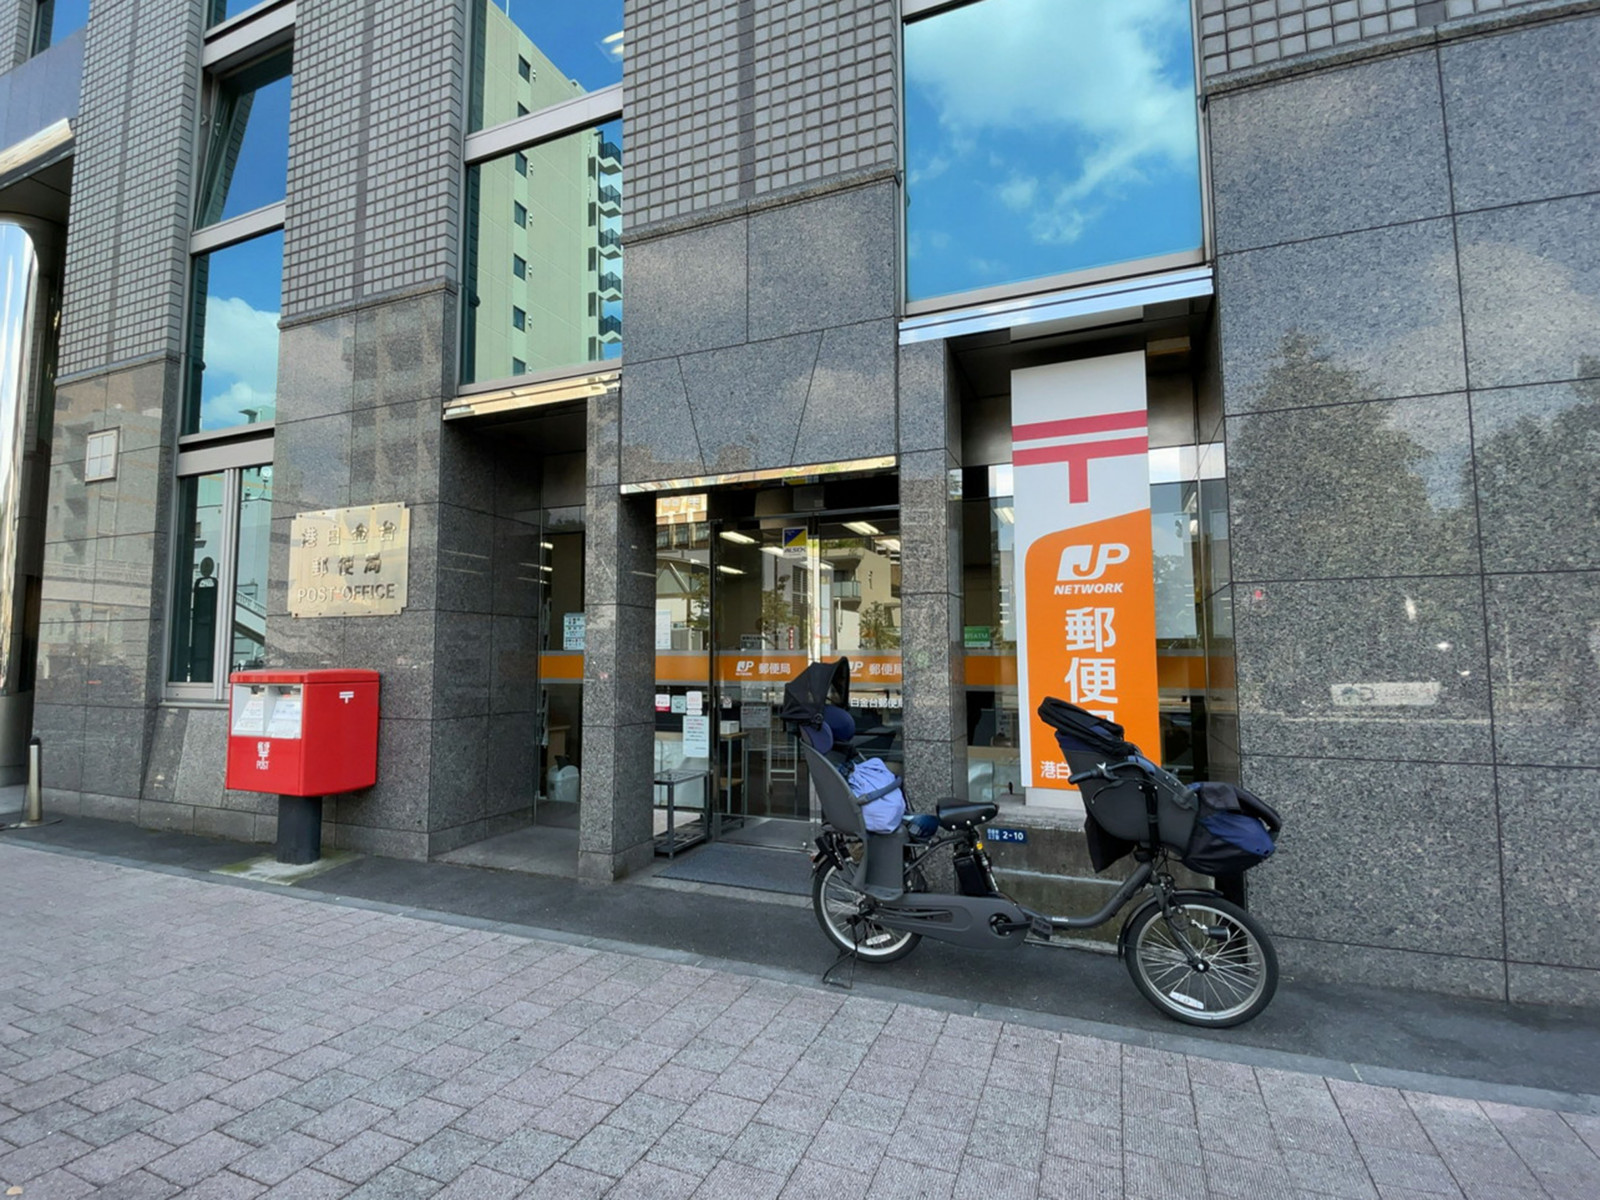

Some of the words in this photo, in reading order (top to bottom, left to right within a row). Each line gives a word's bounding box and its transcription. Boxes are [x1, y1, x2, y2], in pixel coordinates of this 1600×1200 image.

[302, 520, 396, 548] 港白金台
[312, 552, 382, 577] 郵便局
[1056, 543, 1130, 581] JP
[298, 586, 336, 603] POST
[342, 583, 396, 601] OFFICE
[1054, 583, 1124, 595] NETWORK
[758, 663, 791, 675] 郵便局
[1064, 607, 1118, 724] 郵便
[850, 697, 902, 708] 白金台郵便
[1002, 831, 1024, 840] 2-10
